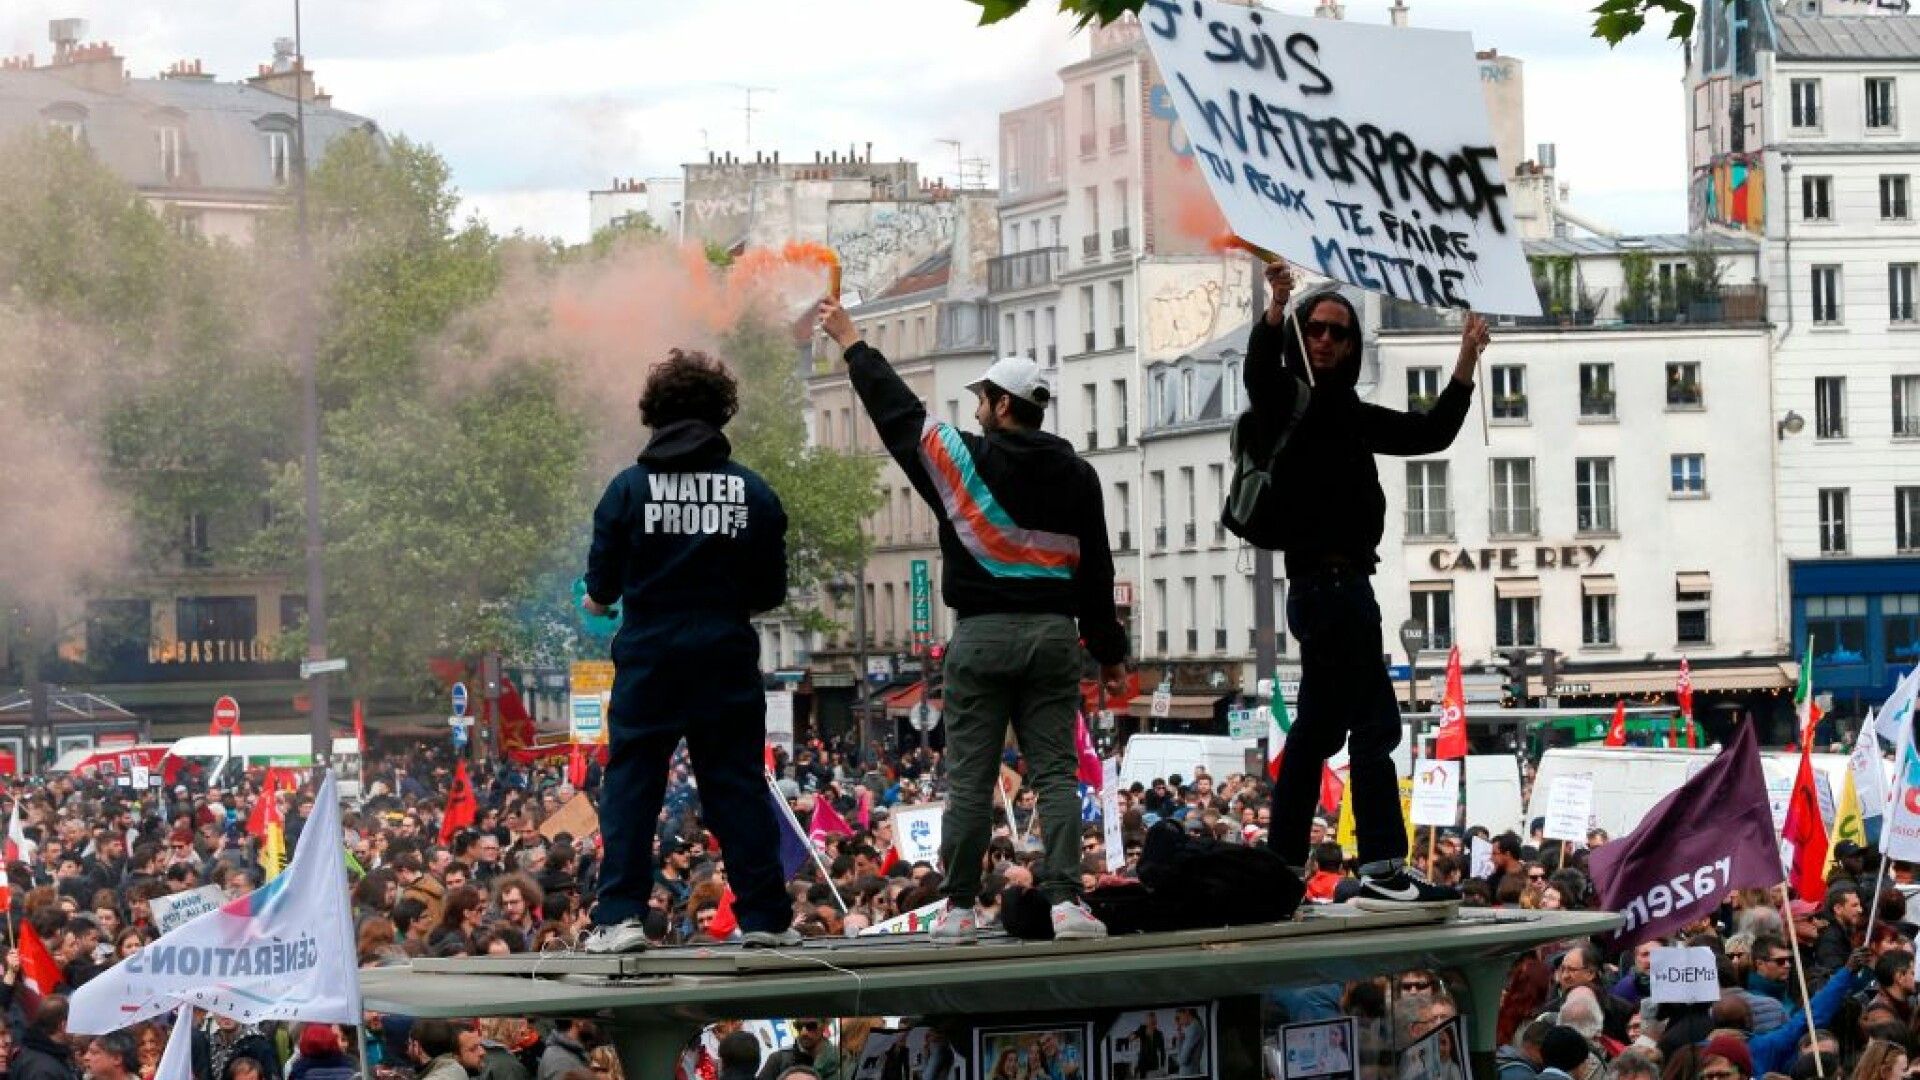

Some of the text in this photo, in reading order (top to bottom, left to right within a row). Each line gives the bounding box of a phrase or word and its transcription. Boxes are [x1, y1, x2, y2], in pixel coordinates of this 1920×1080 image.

[1176, 71, 1508, 235] WATERPROOF
[1197, 144, 1236, 186] TU
[1242, 161, 1316, 221] PEUX
[1326, 199, 1374, 236] TE
[1311, 235, 1471, 311] METTRE
[648, 473, 745, 503] WATER
[1429, 545, 1605, 572] CAFE REY
[177, 640, 273, 663] BASTILL
